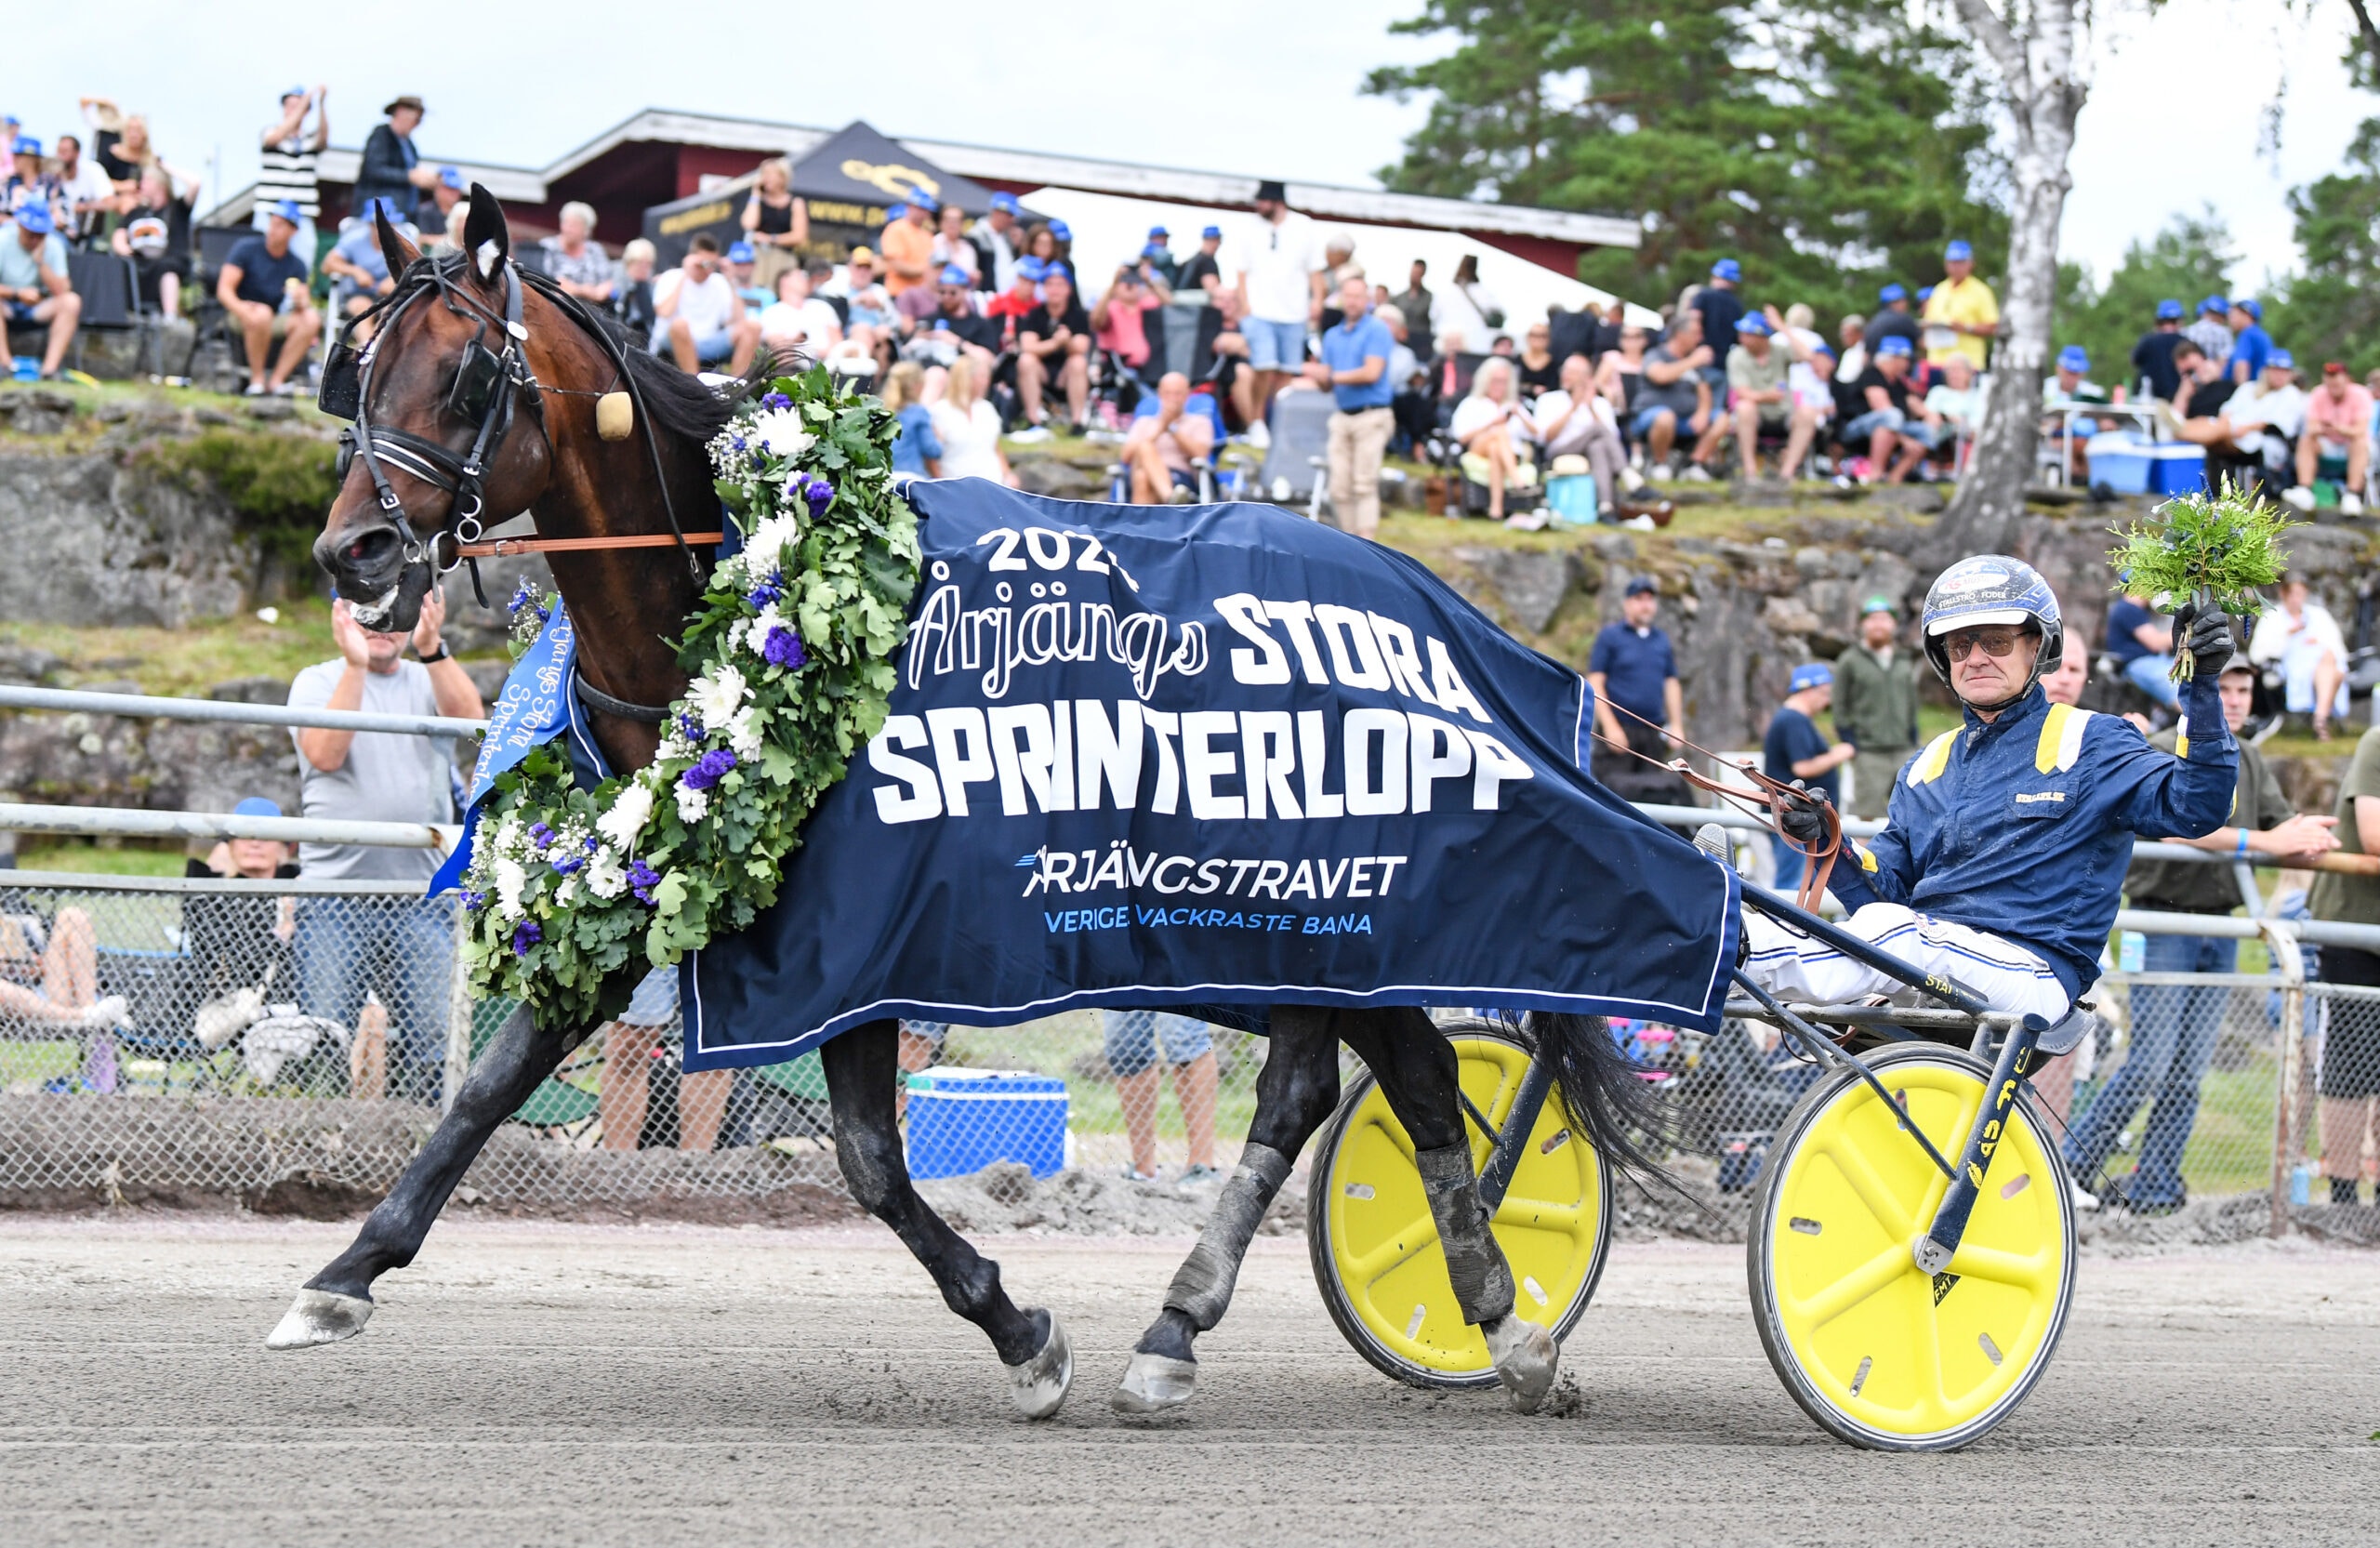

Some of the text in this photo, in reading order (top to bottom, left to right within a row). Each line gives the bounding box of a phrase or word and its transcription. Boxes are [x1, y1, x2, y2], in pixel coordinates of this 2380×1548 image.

[906, 561, 1493, 723] Årjängs STORA
[469, 684, 531, 801] Sprinterlo
[866, 699, 1534, 826] SPRINTERLOPP
[1135, 903, 1297, 933] VACKRASTE
[1302, 913, 1372, 935] BANA
